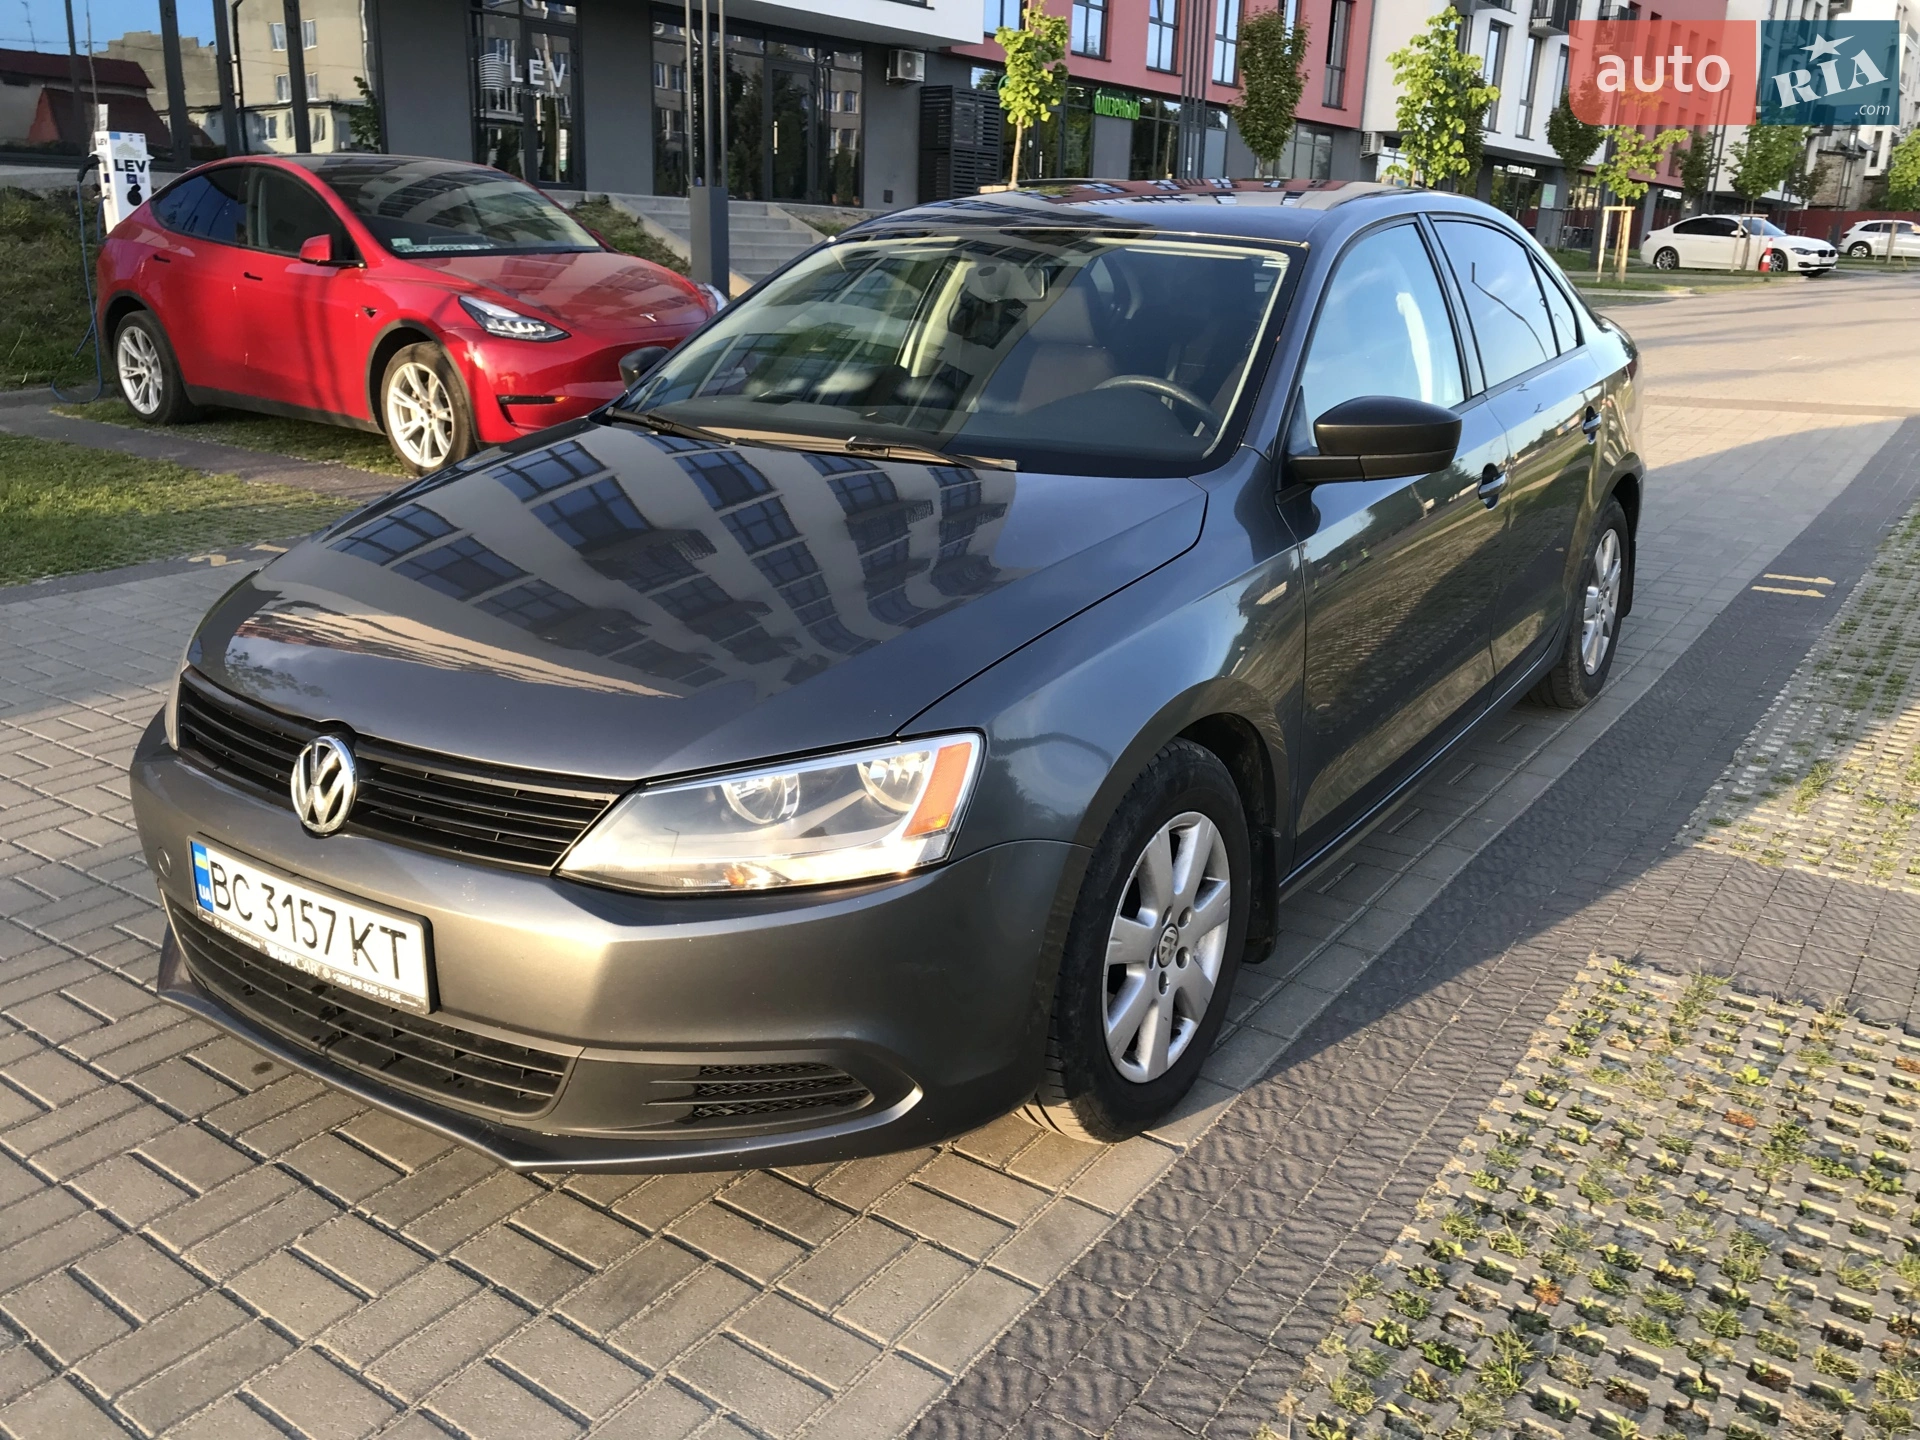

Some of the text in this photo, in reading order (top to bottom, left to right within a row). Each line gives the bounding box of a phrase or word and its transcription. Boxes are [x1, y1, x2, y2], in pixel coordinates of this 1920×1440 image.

[510, 56, 566, 88] LEV
[113, 159, 147, 173] LEV
[198, 883, 213, 904] UA
[210, 860, 407, 981] BC 3157 KT
